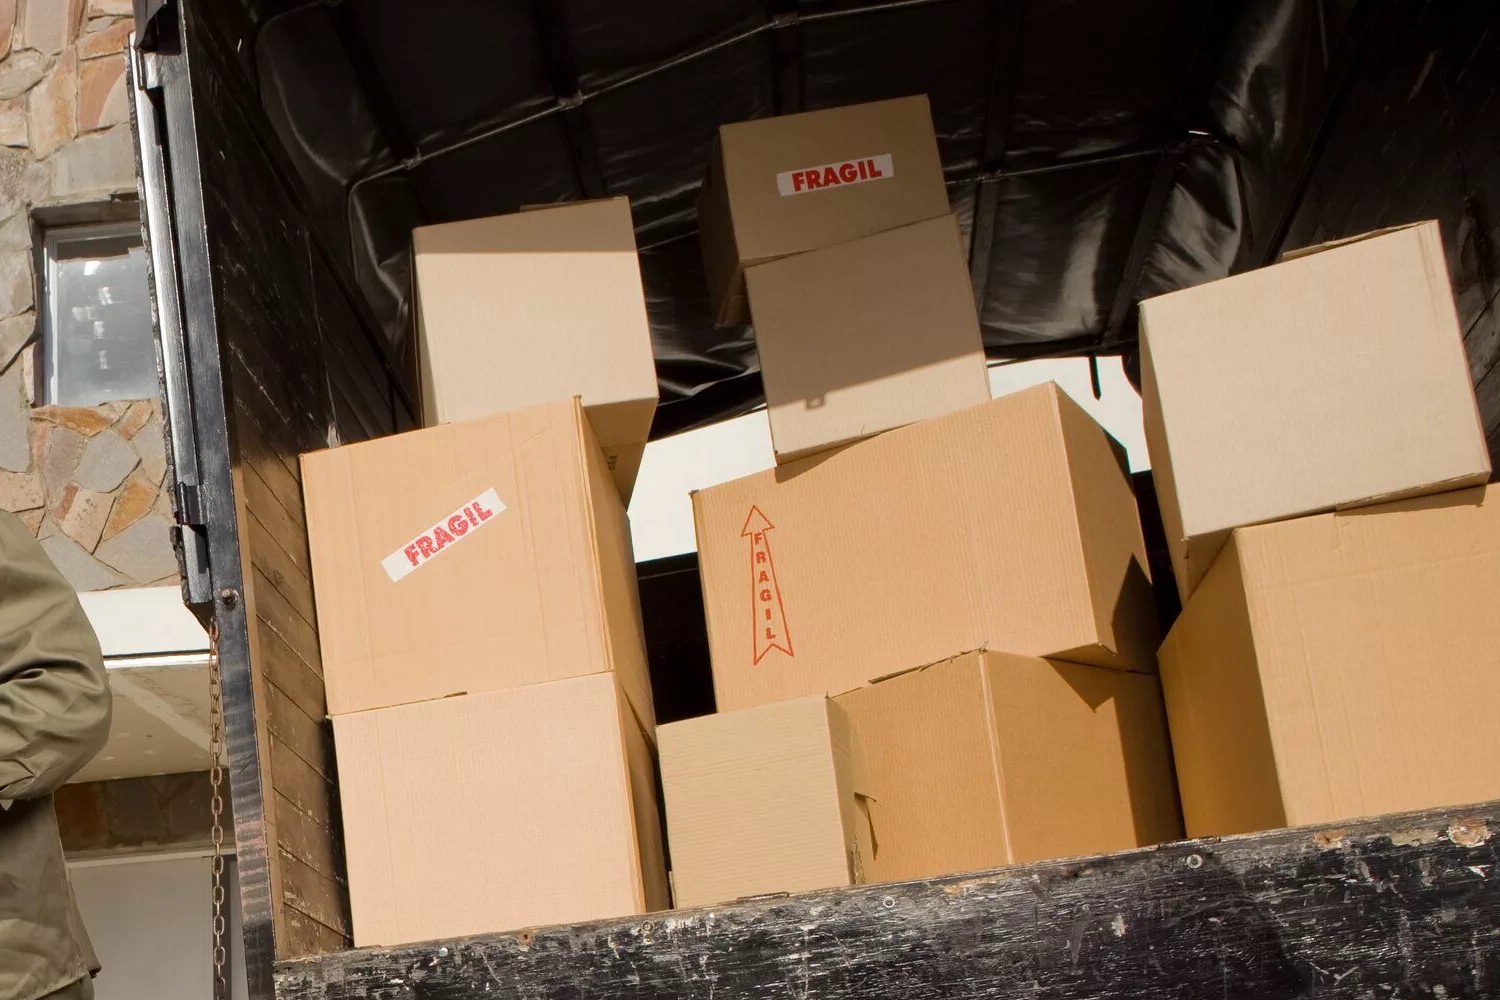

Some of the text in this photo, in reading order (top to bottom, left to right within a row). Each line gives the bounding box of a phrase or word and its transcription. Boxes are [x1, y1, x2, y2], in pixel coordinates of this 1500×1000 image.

[791, 159, 882, 192] FRAGIL
[404, 501, 493, 567] FRAGIL
[754, 531, 776, 640] FRAGIL
